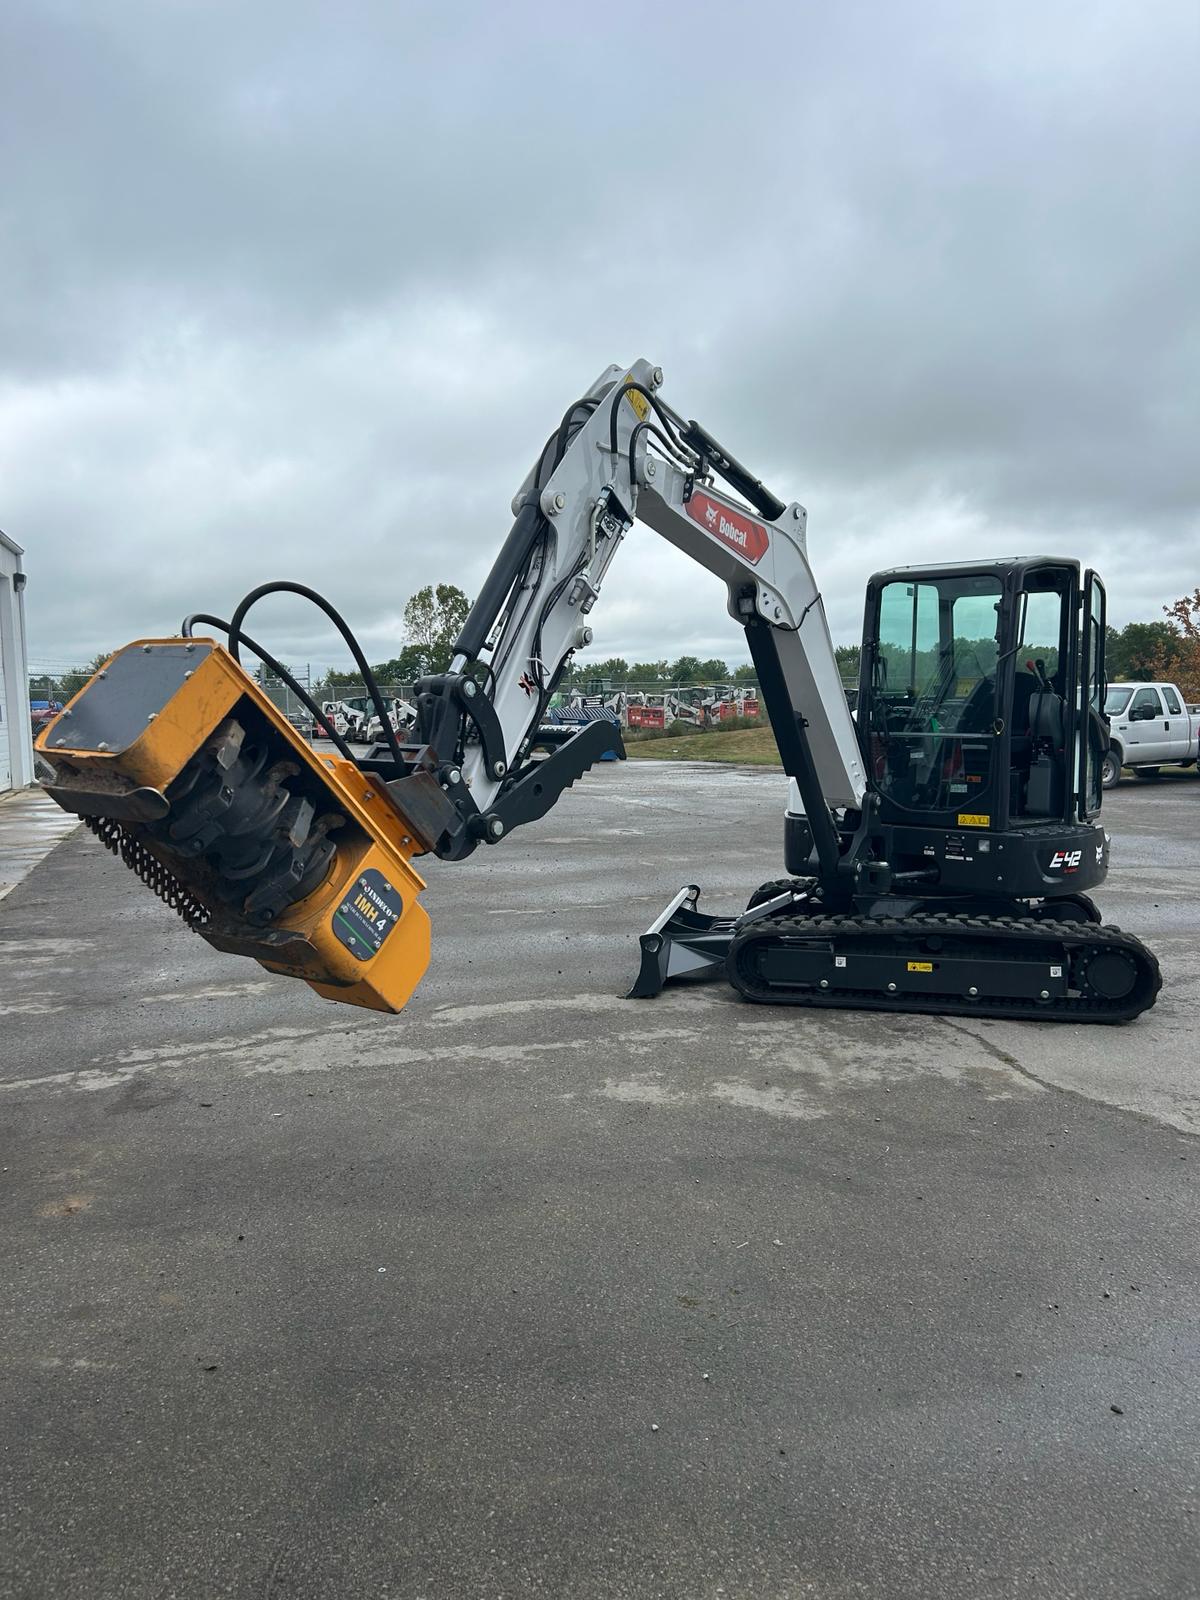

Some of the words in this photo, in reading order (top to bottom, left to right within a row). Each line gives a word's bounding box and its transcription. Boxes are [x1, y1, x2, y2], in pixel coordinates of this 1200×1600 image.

[719, 515, 747, 547] Bobcat
[1049, 850, 1082, 868] E42
[375, 918, 387, 931] 4
